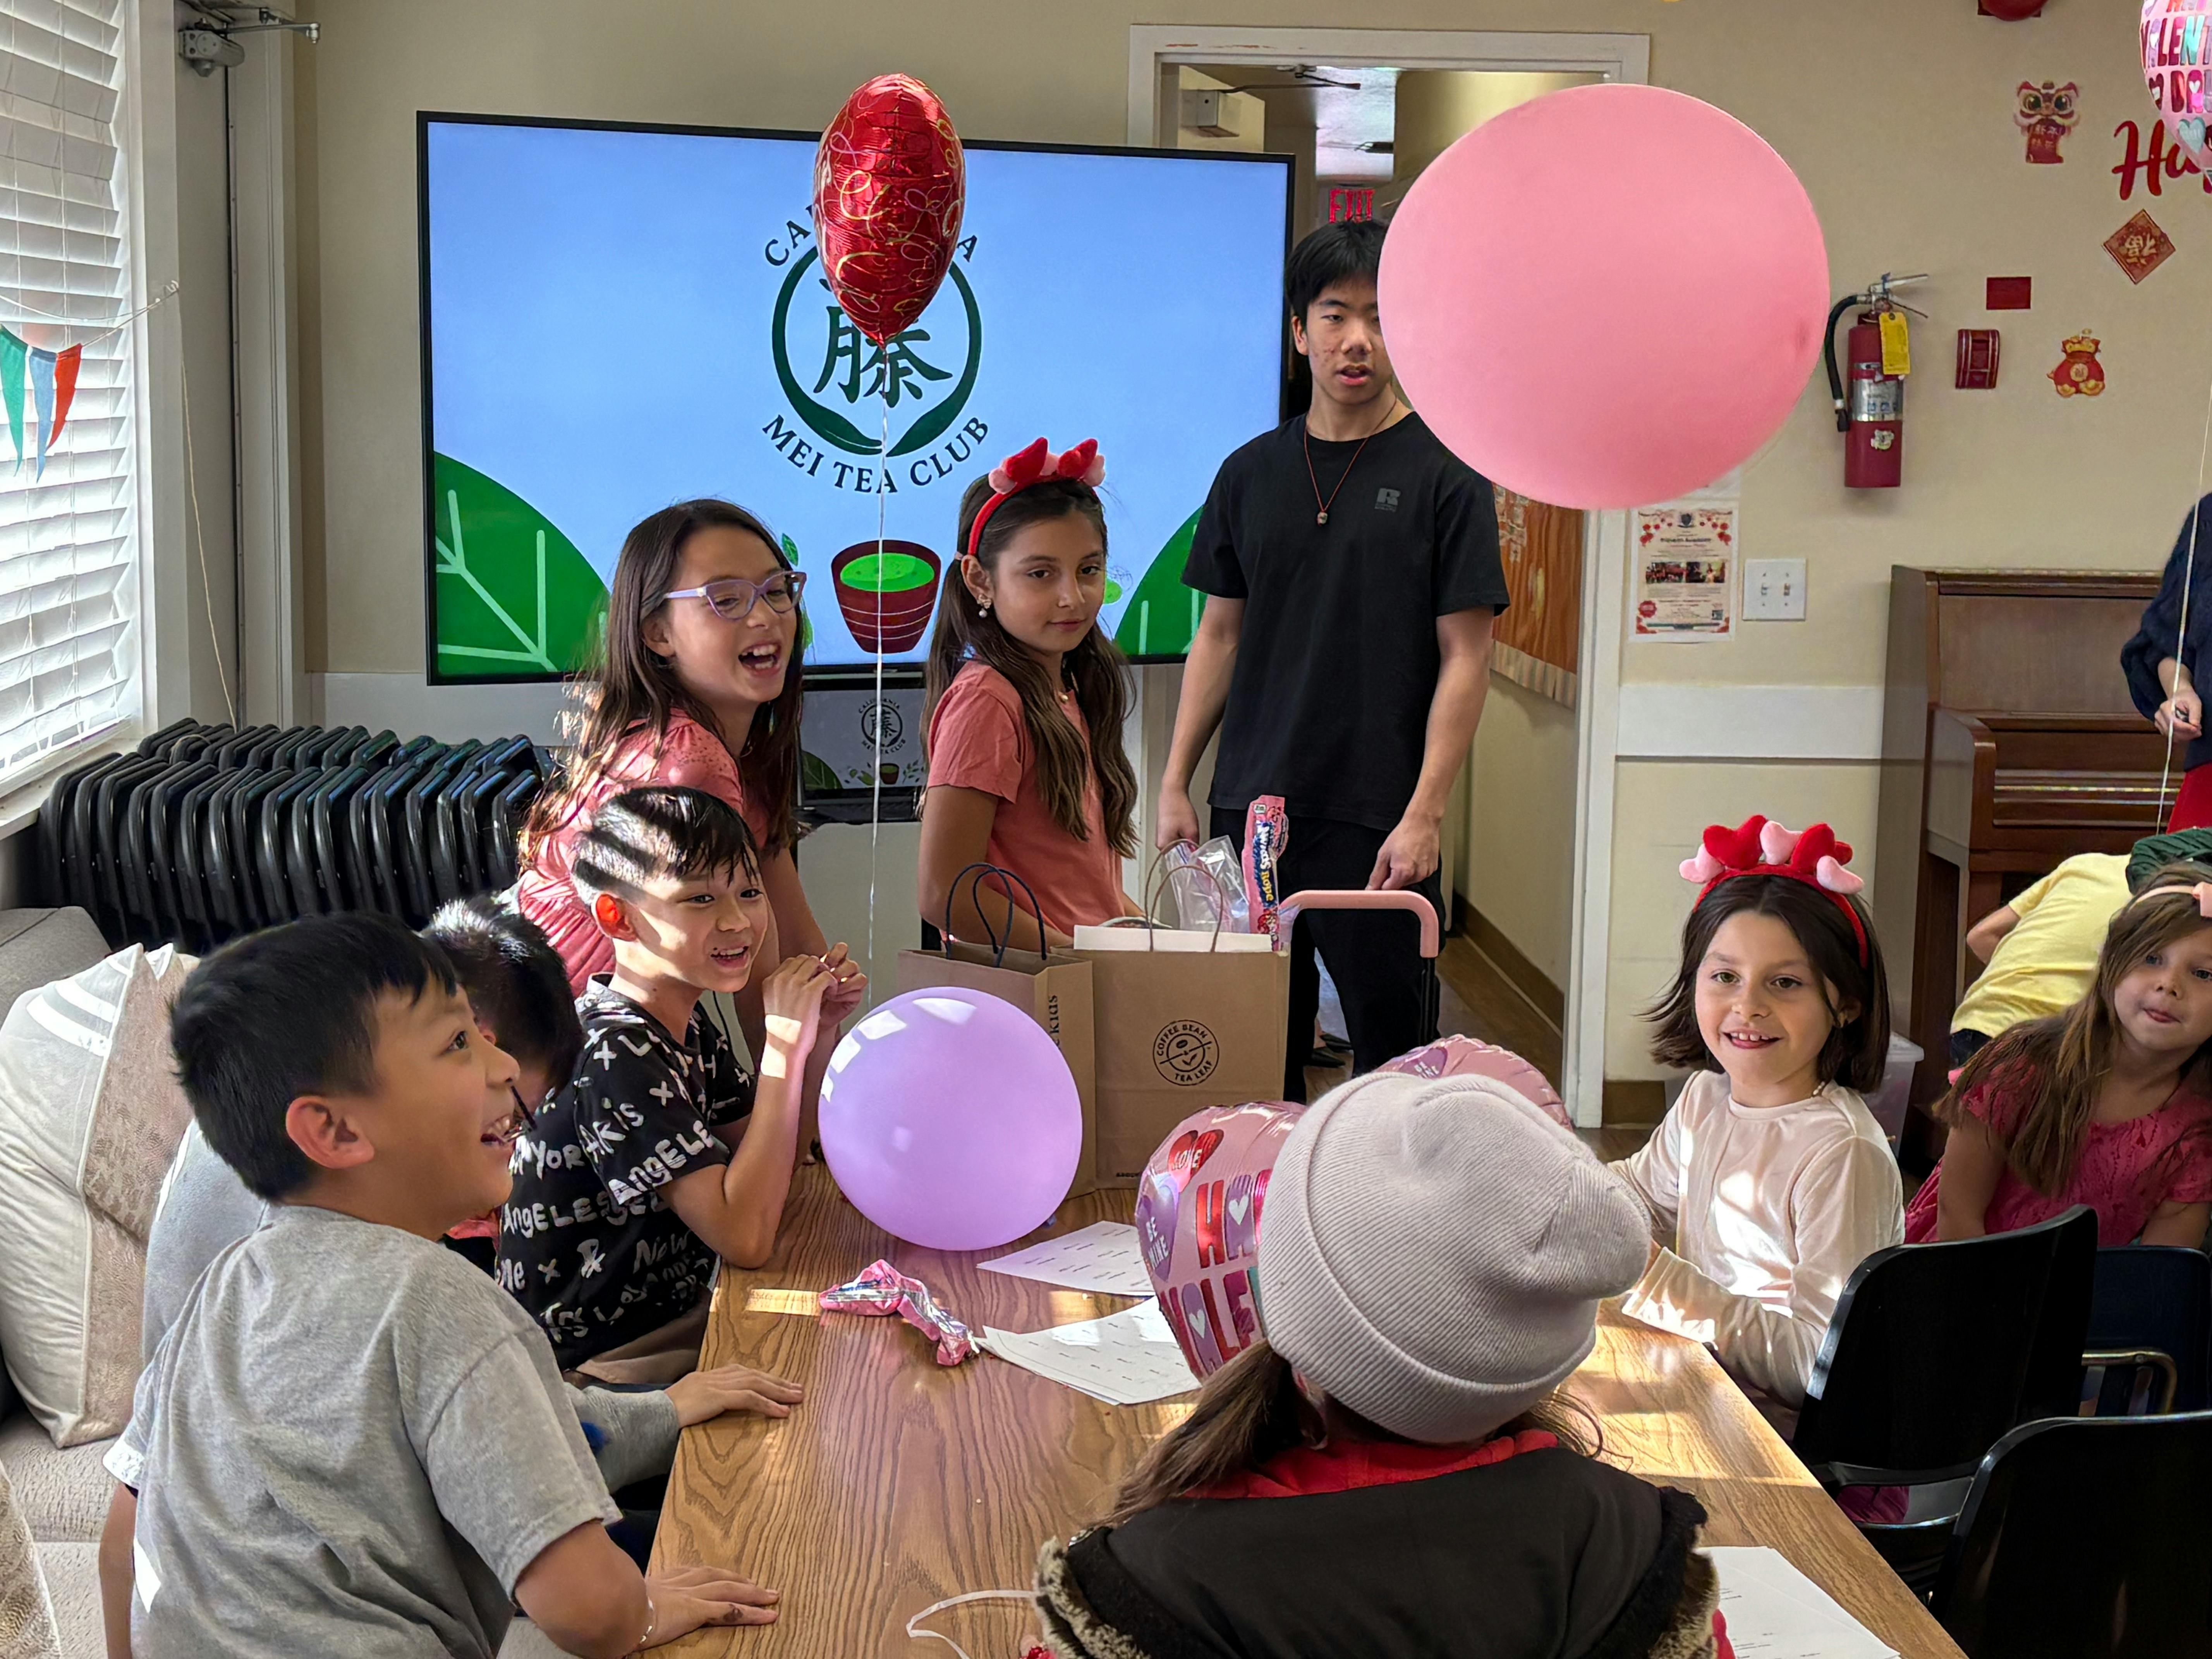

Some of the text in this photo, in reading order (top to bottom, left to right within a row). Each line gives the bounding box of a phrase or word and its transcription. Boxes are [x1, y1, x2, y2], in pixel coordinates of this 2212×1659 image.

[762, 414, 989, 494] MEI TEA CLUB
[1156, 1024, 1208, 1056] COFFEE BEAN
[1175, 1060, 1212, 1082] TEA LEAF
[1172, 1149, 1202, 1170] LOVE
[1146, 1216, 1159, 1242] BE
[1148, 1235, 1170, 1270] MINE
